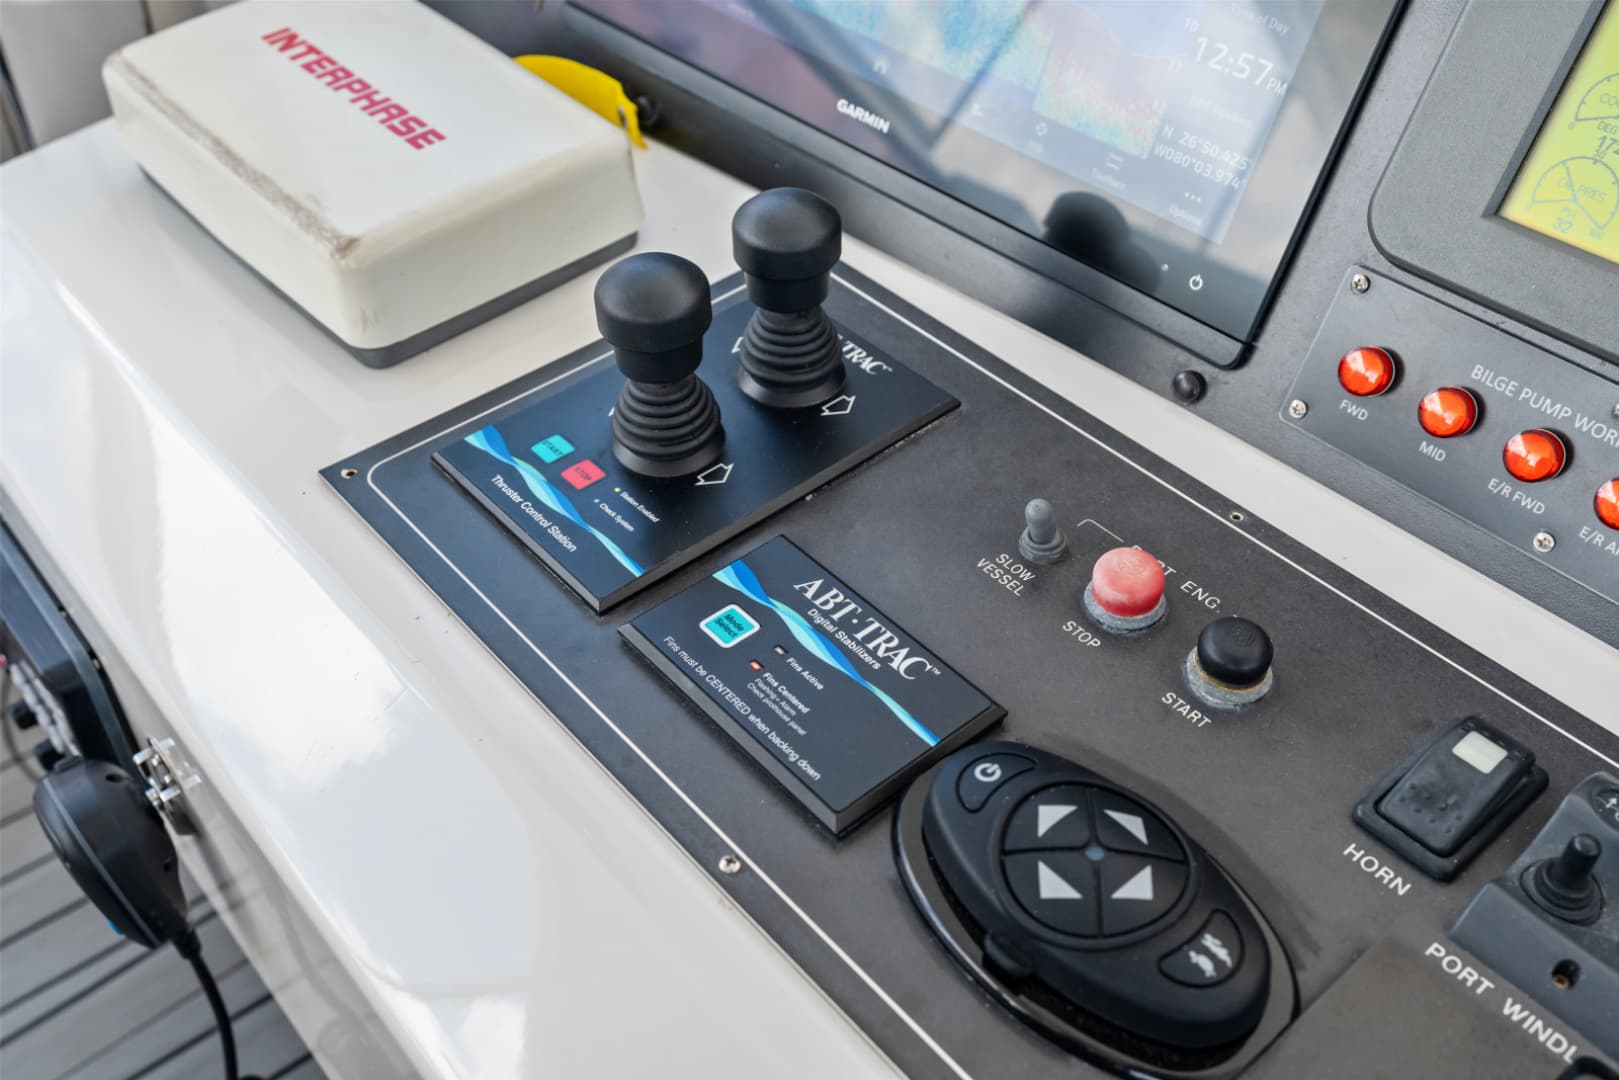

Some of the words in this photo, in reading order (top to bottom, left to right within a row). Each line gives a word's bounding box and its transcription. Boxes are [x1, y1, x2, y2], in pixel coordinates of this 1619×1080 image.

[261, 26, 448, 152] INTERPHASE
[836, 98, 890, 133] GARMIN
[1339, 399, 1369, 421] FWD
[1470, 363, 1517, 398] BILGE
[1519, 387, 1572, 421] PUMP
[1574, 413, 1619, 448] WOR
[1418, 440, 1447, 462] MID
[491, 474, 523, 503] Thruster
[521, 502, 551, 528] Control
[549, 525, 577, 552] Station
[1487, 478, 1512, 498] E/R
[1511, 490, 1546, 516] FWD
[1579, 525, 1605, 547] E/R
[976, 558, 1025, 597] VESSEL
[995, 553, 1036, 582] SLOW
[1180, 580, 1222, 613] ENG.
[714, 619, 738, 639] Select
[724, 614, 744, 633] Mode
[807, 608, 837, 634] Digital
[834, 629, 881, 670] Stabilizers
[1062, 620, 1101, 648] STOP
[786, 657, 803, 673] Fins
[800, 670, 824, 691] Active
[663, 635, 681, 653] Fins
[678, 650, 698, 668] must
[695, 665, 708, 677] be
[705, 673, 751, 716] CENTERED
[747, 714, 771, 735] when
[767, 727, 799, 763] backing
[797, 757, 821, 781] down
[762, 672, 780, 688] Fins
[777, 685, 811, 715] Centered
[1161, 691, 1212, 728] START
[1343, 843, 1412, 896] HORN
[1424, 942, 1496, 995] PORT
